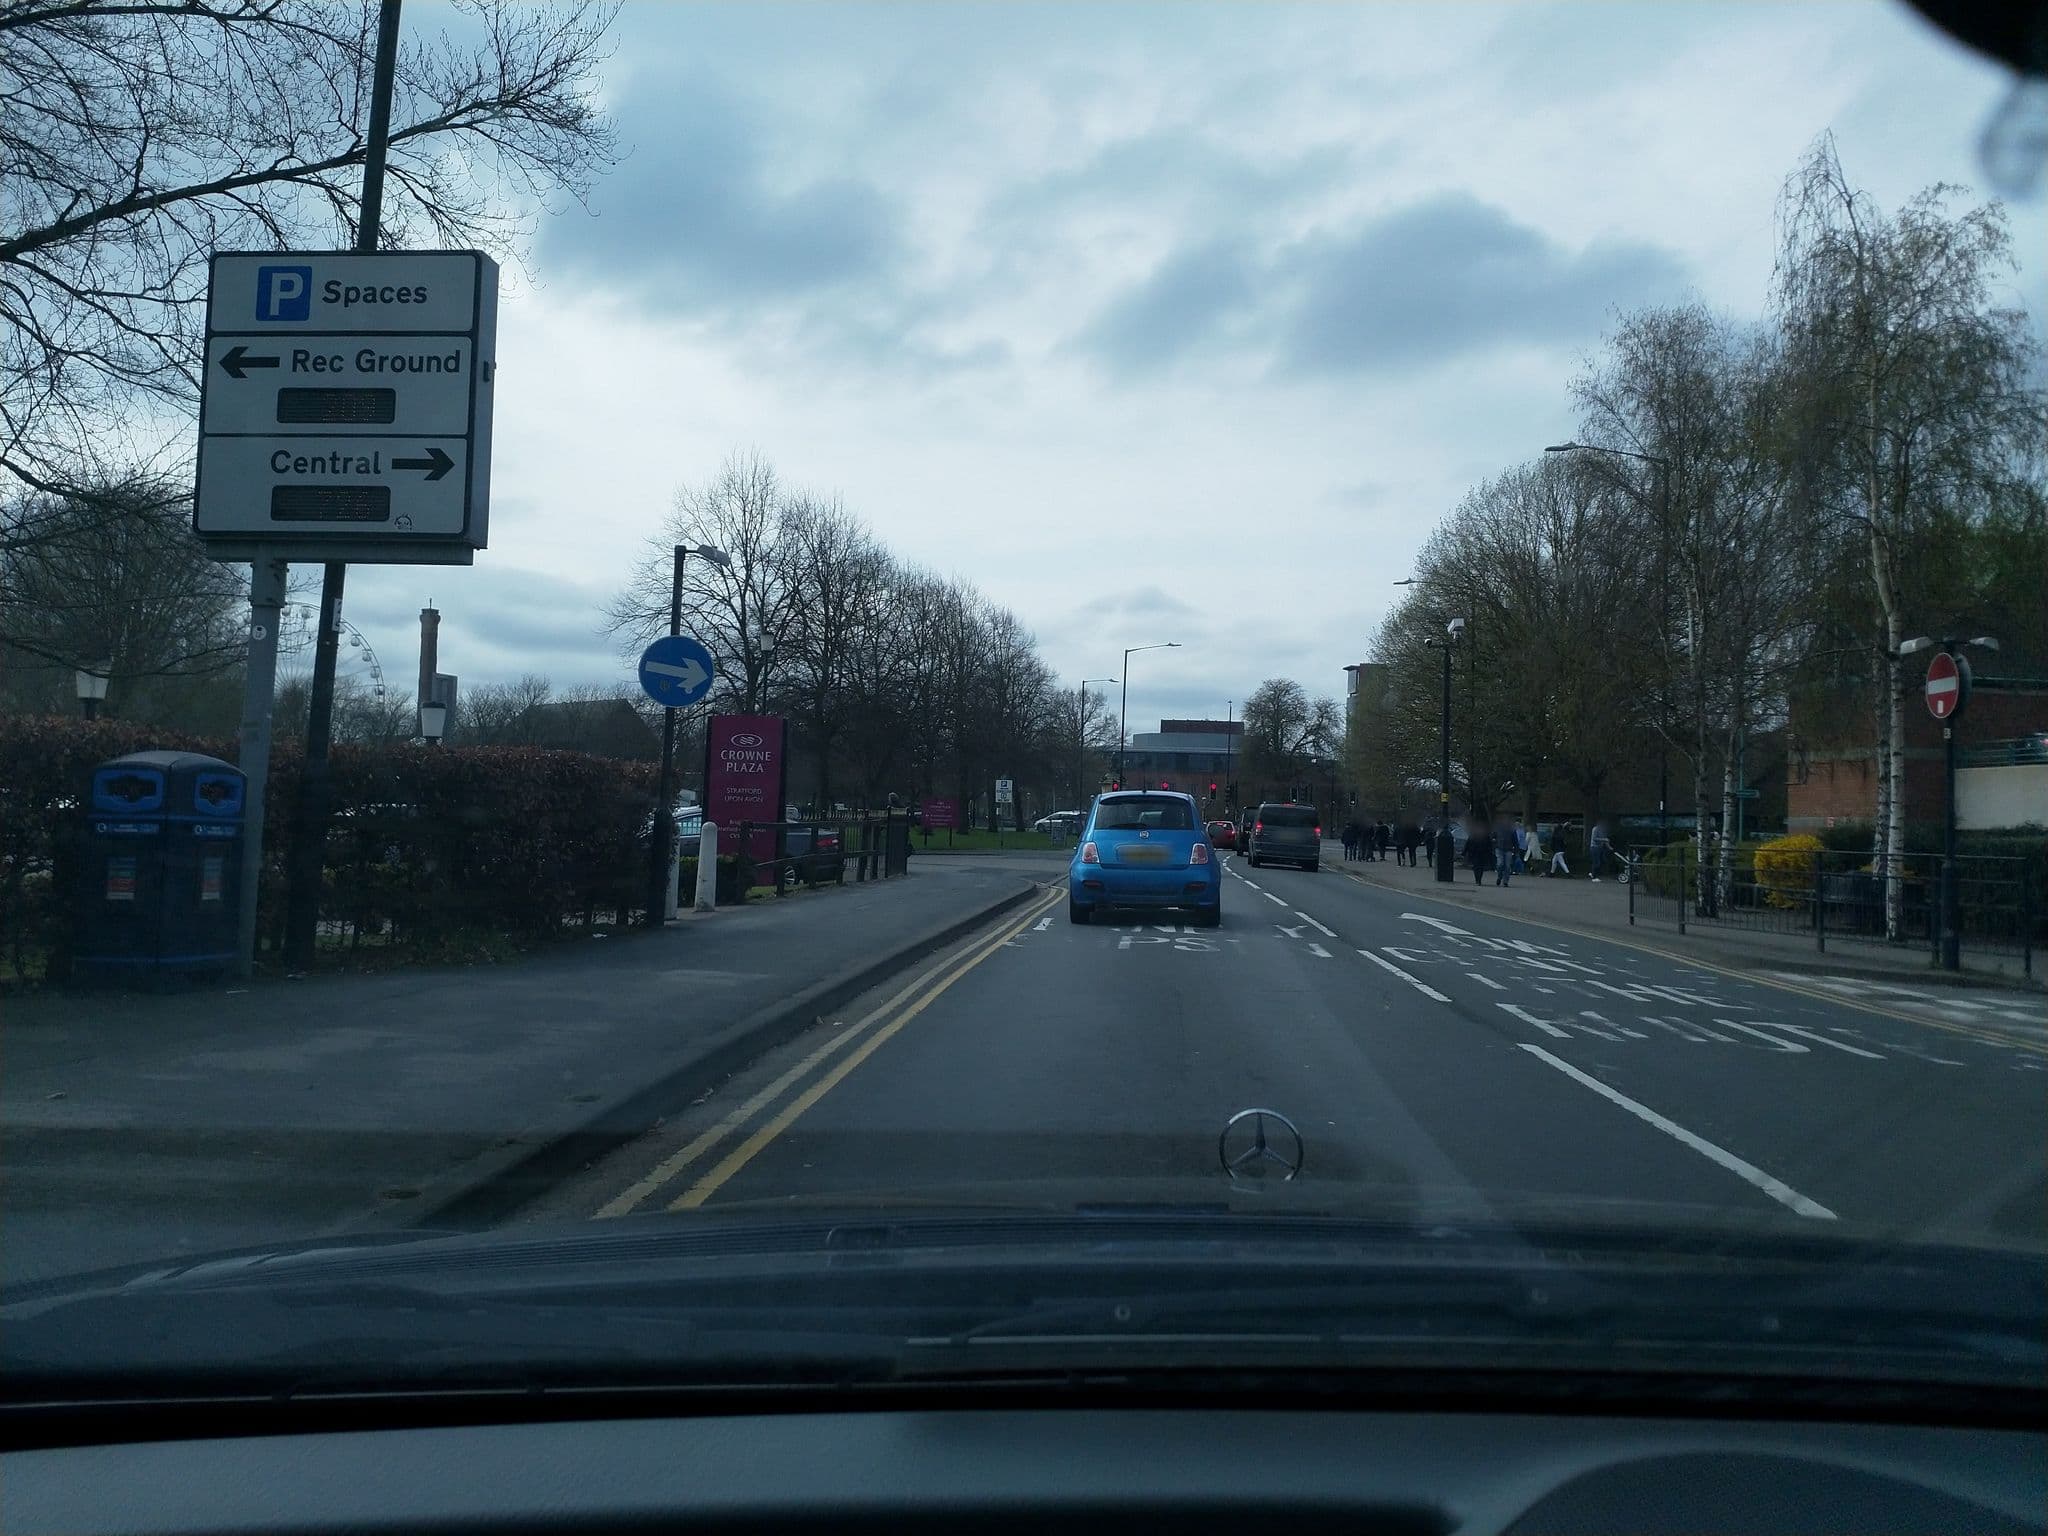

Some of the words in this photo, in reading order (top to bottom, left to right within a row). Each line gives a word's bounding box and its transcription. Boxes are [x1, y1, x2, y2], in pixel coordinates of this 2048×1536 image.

[268, 271, 304, 317] P
[322, 280, 428, 308] Spaces
[291, 349, 344, 373] Rec
[355, 349, 461, 374] Ground
[270, 450, 382, 475] Central
[720, 749, 772, 762] CROWNE
[726, 762, 765, 773] PLAZA
